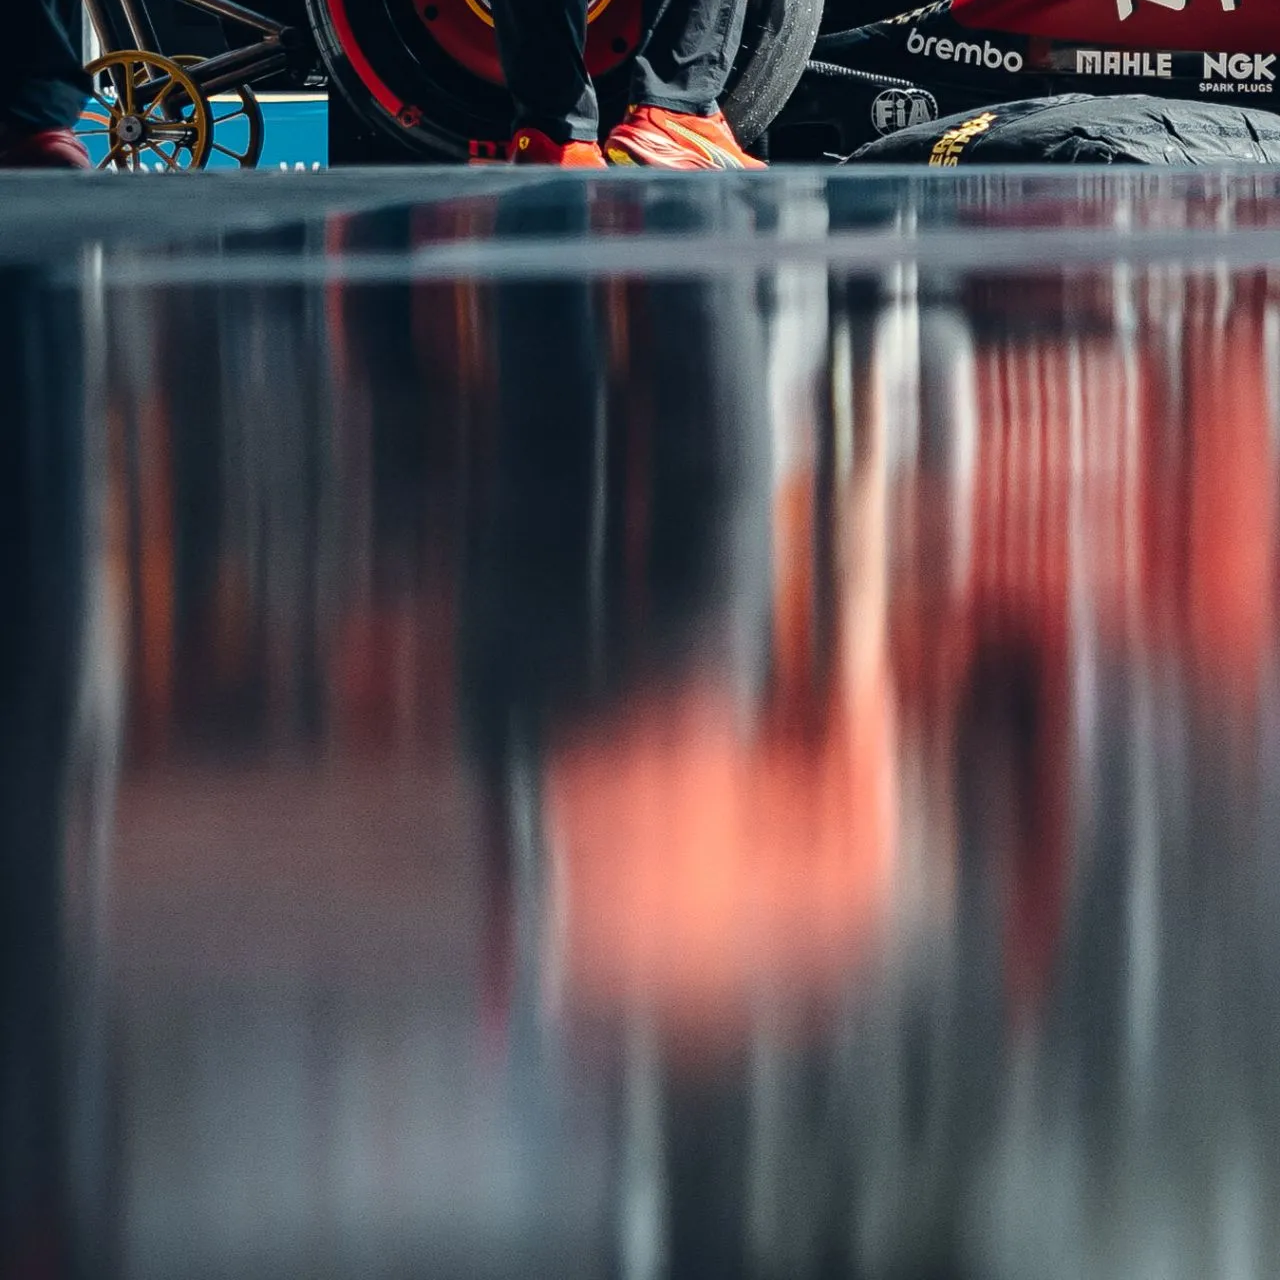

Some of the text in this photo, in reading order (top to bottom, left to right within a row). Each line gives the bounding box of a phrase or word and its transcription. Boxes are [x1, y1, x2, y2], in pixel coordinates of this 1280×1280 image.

[906, 27, 1024, 73] brembo
[1076, 50, 1172, 77] MAHLE
[1203, 52, 1277, 81] NGK
[1198, 82, 1273, 93] SPARK PLUGS
